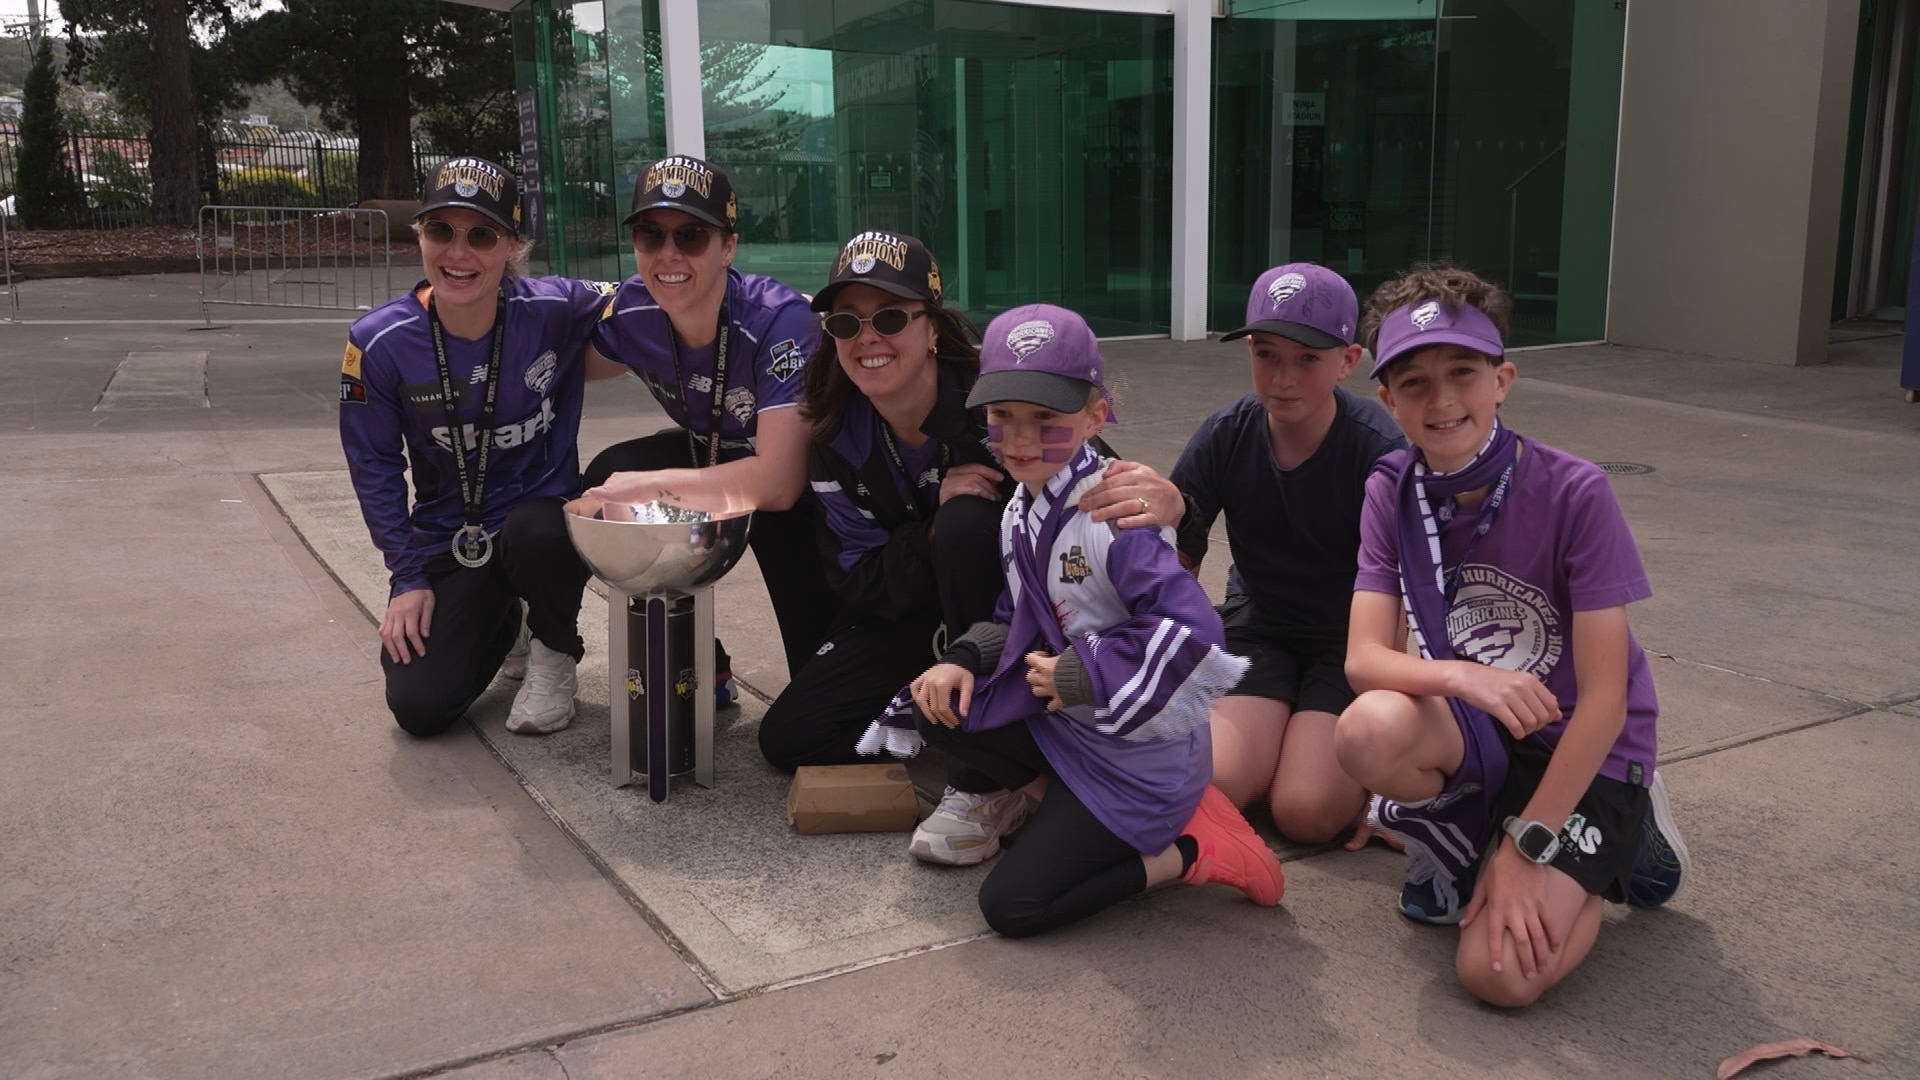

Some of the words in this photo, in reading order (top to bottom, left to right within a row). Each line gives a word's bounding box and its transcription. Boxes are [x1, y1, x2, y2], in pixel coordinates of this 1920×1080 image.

[435, 164, 505, 202] CHAMPIONS
[447, 159, 498, 178] WBBL11
[643, 165, 713, 199] CHAMPIONS
[655, 157, 705, 174] WBBL11
[432, 321, 446, 365] CHAMPIONS
[717, 326, 728, 371] CHAMPIONS
[1490, 466, 1512, 508] MEMBER
[1461, 569, 1558, 626] HURRICANES
[1446, 606, 1528, 647] HURRICANES
[1531, 634, 1563, 683] HOBA
